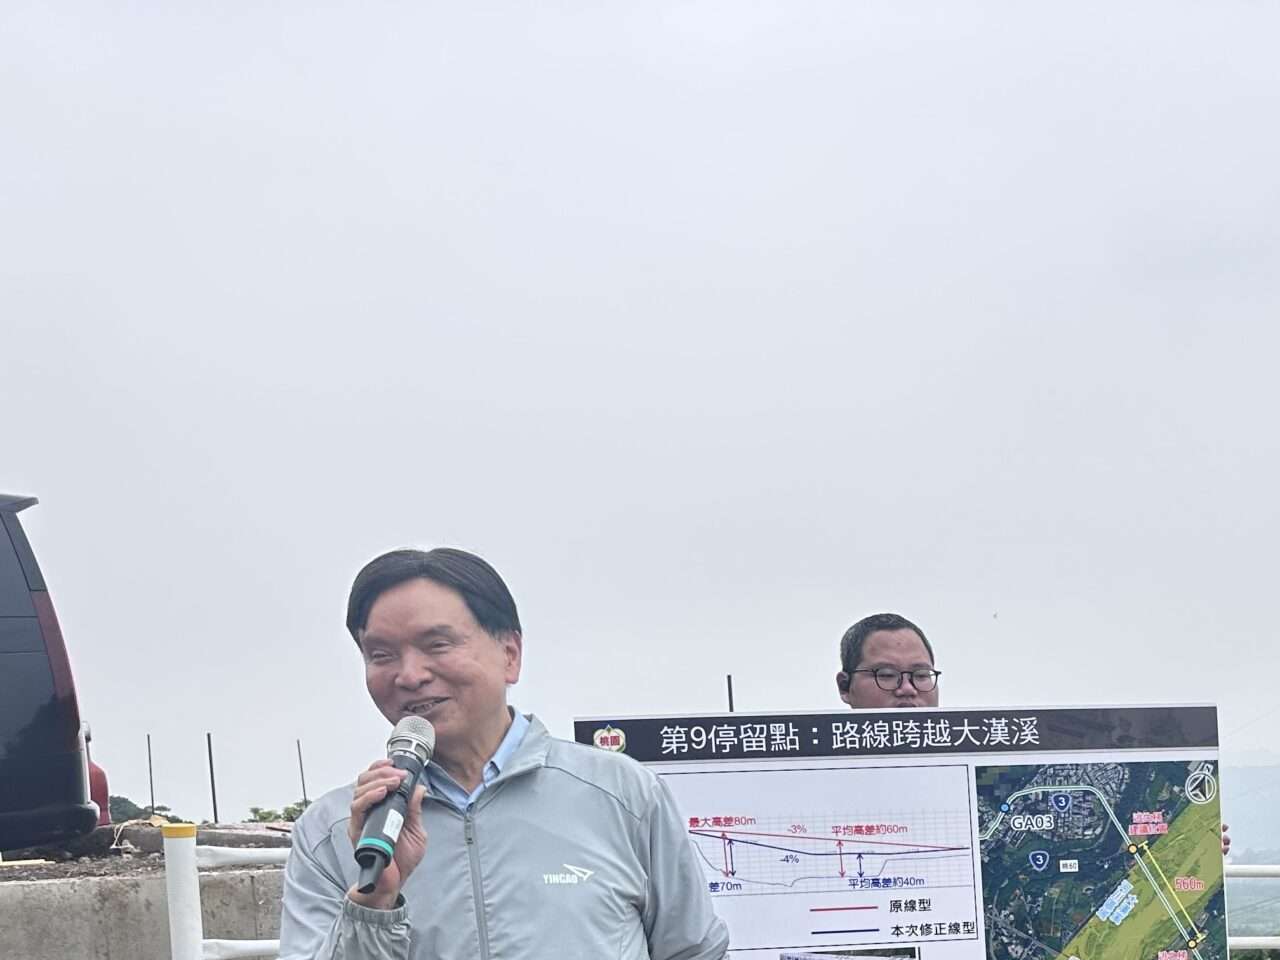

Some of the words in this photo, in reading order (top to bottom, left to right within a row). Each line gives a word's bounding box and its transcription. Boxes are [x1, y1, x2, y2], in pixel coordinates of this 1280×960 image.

[1057, 796, 1066, 807] 3
[688, 816, 756, 828] 最大高差80m
[1011, 815, 1054, 830] GA03
[832, 824, 908, 836] 平均高差約60m
[779, 854, 799, 865] -4%
[1035, 854, 1044, 865] 3
[848, 878, 925, 889] 平均高差約40m
[889, 898, 932, 913] 原線型
[890, 921, 976, 937] 本次修正線型
